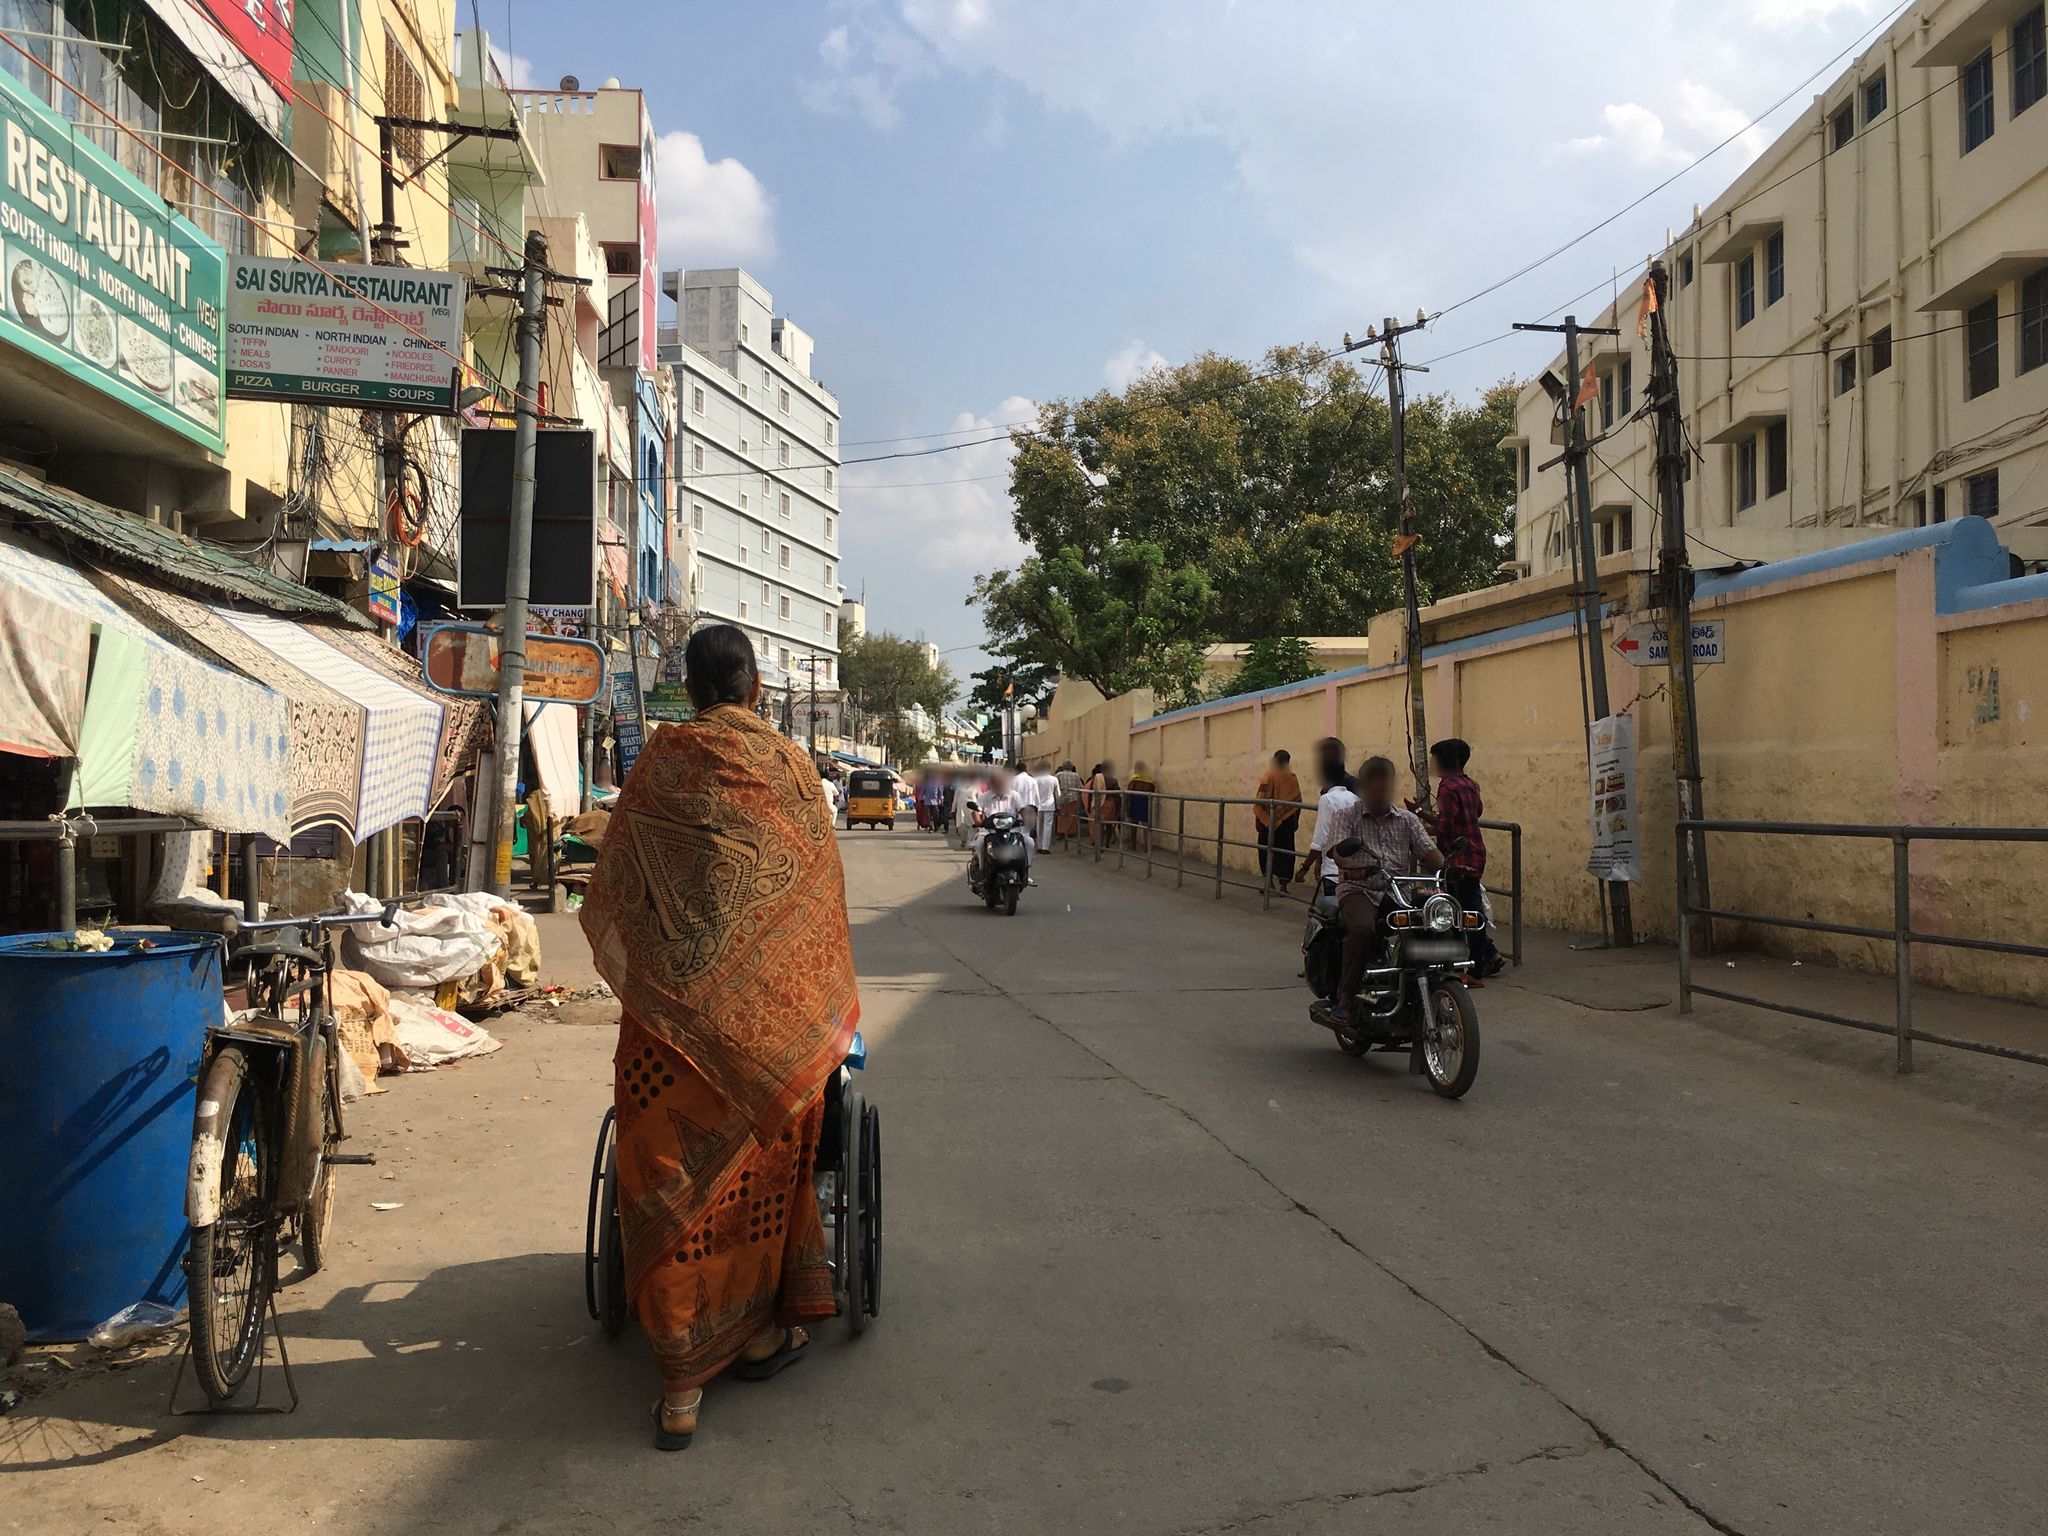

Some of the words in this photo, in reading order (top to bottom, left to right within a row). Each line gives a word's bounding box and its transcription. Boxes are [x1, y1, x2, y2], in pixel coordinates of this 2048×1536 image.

[7, 118, 191, 310] RESTAURANT
[1, 202, 46, 252] SOUTH
[49, 232, 90, 281] INDIAN
[99, 267, 137, 311] NORTH
[138, 290, 172, 335] INDIAN
[179, 322, 217, 365] CHINESE
[235, 267, 265, 291] SAI
[269, 269, 328, 296] SURYA
[332, 274, 453, 306] RESTAURANT
[197, 296, 219, 338] (VEG)
[431, 307, 450, 318] (VEG)
[228, 324, 263, 336] SOUTH
[265, 327, 299, 339] INDIAN
[315, 331, 351, 342] NORTH
[353, 333, 387, 346] INDIAN
[403, 338, 447, 350] CHINESE
[241, 337, 267, 347] TIFFIN
[240, 348, 271, 359] MEALS
[325, 344, 369, 356] TANDOORI
[391, 350, 434, 361] NOODLES
[239, 359, 271, 370] DOSA'S
[324, 355, 361, 366] CURRY'S
[322, 366, 358, 377] PANNER
[391, 361, 436, 372] FRIEDRICE
[390, 372, 448, 385] MANCHURIAN
[235, 375, 273, 388] PIZZA
[301, 380, 360, 395] BURGER
[388, 387, 436, 401] SOUPS
[1649, 646, 1668, 659] SAM
[1693, 644, 1718, 657] ROAD
[619, 726, 640, 737] HOTEL
[620, 736, 641, 747] SHANTI
